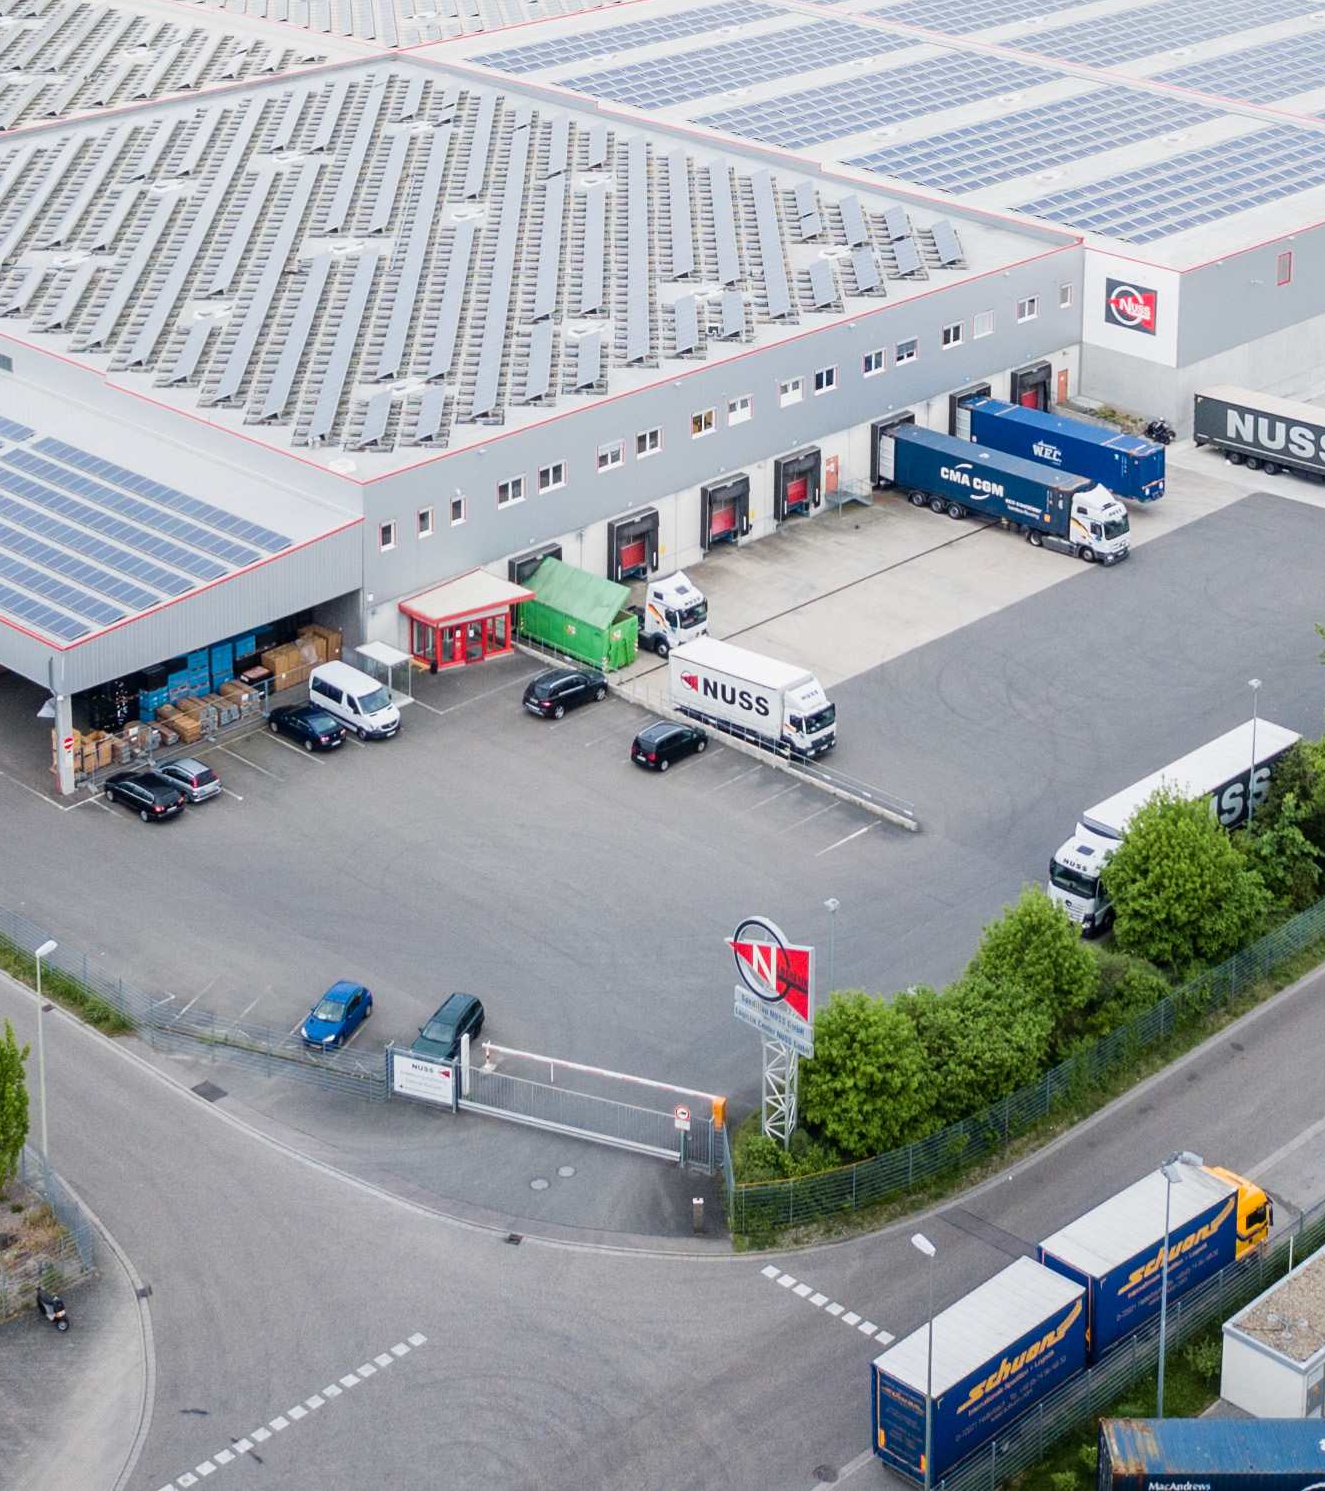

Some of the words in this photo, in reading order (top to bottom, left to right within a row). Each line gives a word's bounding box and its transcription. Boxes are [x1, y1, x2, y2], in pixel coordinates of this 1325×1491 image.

[940, 466, 971, 487] CMA
[972, 477, 1004, 498] CGM
[702, 677, 770, 717] NUSS
[1209, 767, 1272, 825] SS
[1062, 857, 1088, 872] NUSS
[411, 1063, 434, 1073] NUSS
[956, 1296, 1083, 1415] schuon
[1148, 1481, 1211, 1491] MacAndrews
